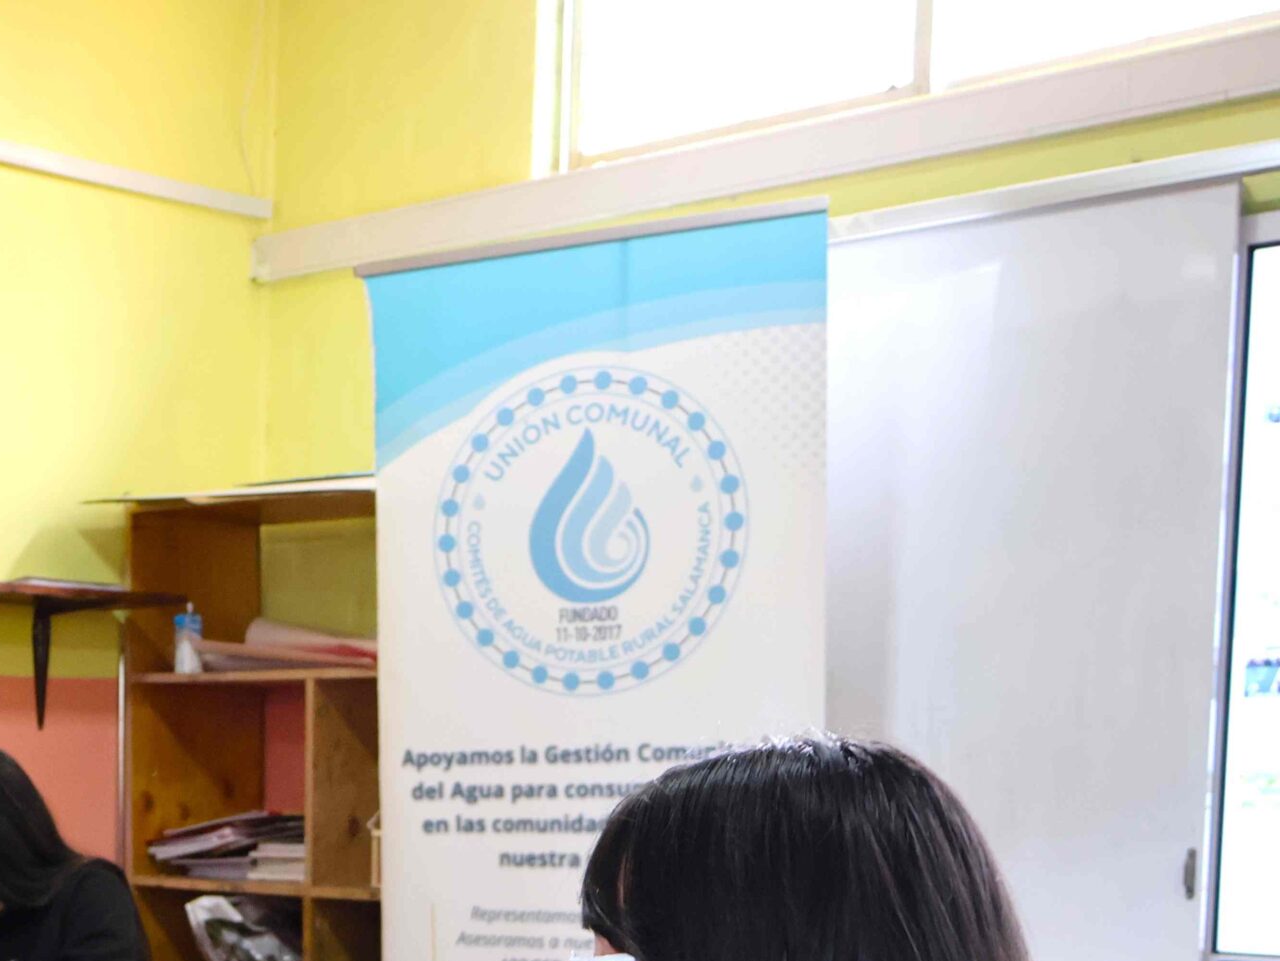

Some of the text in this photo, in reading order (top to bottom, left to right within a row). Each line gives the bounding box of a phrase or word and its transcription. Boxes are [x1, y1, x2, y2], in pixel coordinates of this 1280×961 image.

[565, 402, 691, 469] COMUNAL
[502, 618, 542, 652] AGUA
[544, 643, 619, 663] POTABLE
[622, 615, 673, 655] RURAL
[671, 501, 712, 614] SALAMANCA
[558, 605, 619, 622] FUNDADO
[556, 624, 623, 642] 11-10-2017
[402, 747, 515, 771] Apoyamos
[520, 745, 538, 765] la
[545, 743, 630, 765] Gestión
[412, 781, 444, 801] del
[451, 783, 505, 805] Agua
[511, 784, 557, 803] para
[423, 818, 448, 834] en
[456, 814, 485, 833] las
[499, 851, 580, 868] nuestra
[455, 932, 544, 948] Asesoramos
[548, 937, 559, 948] a
